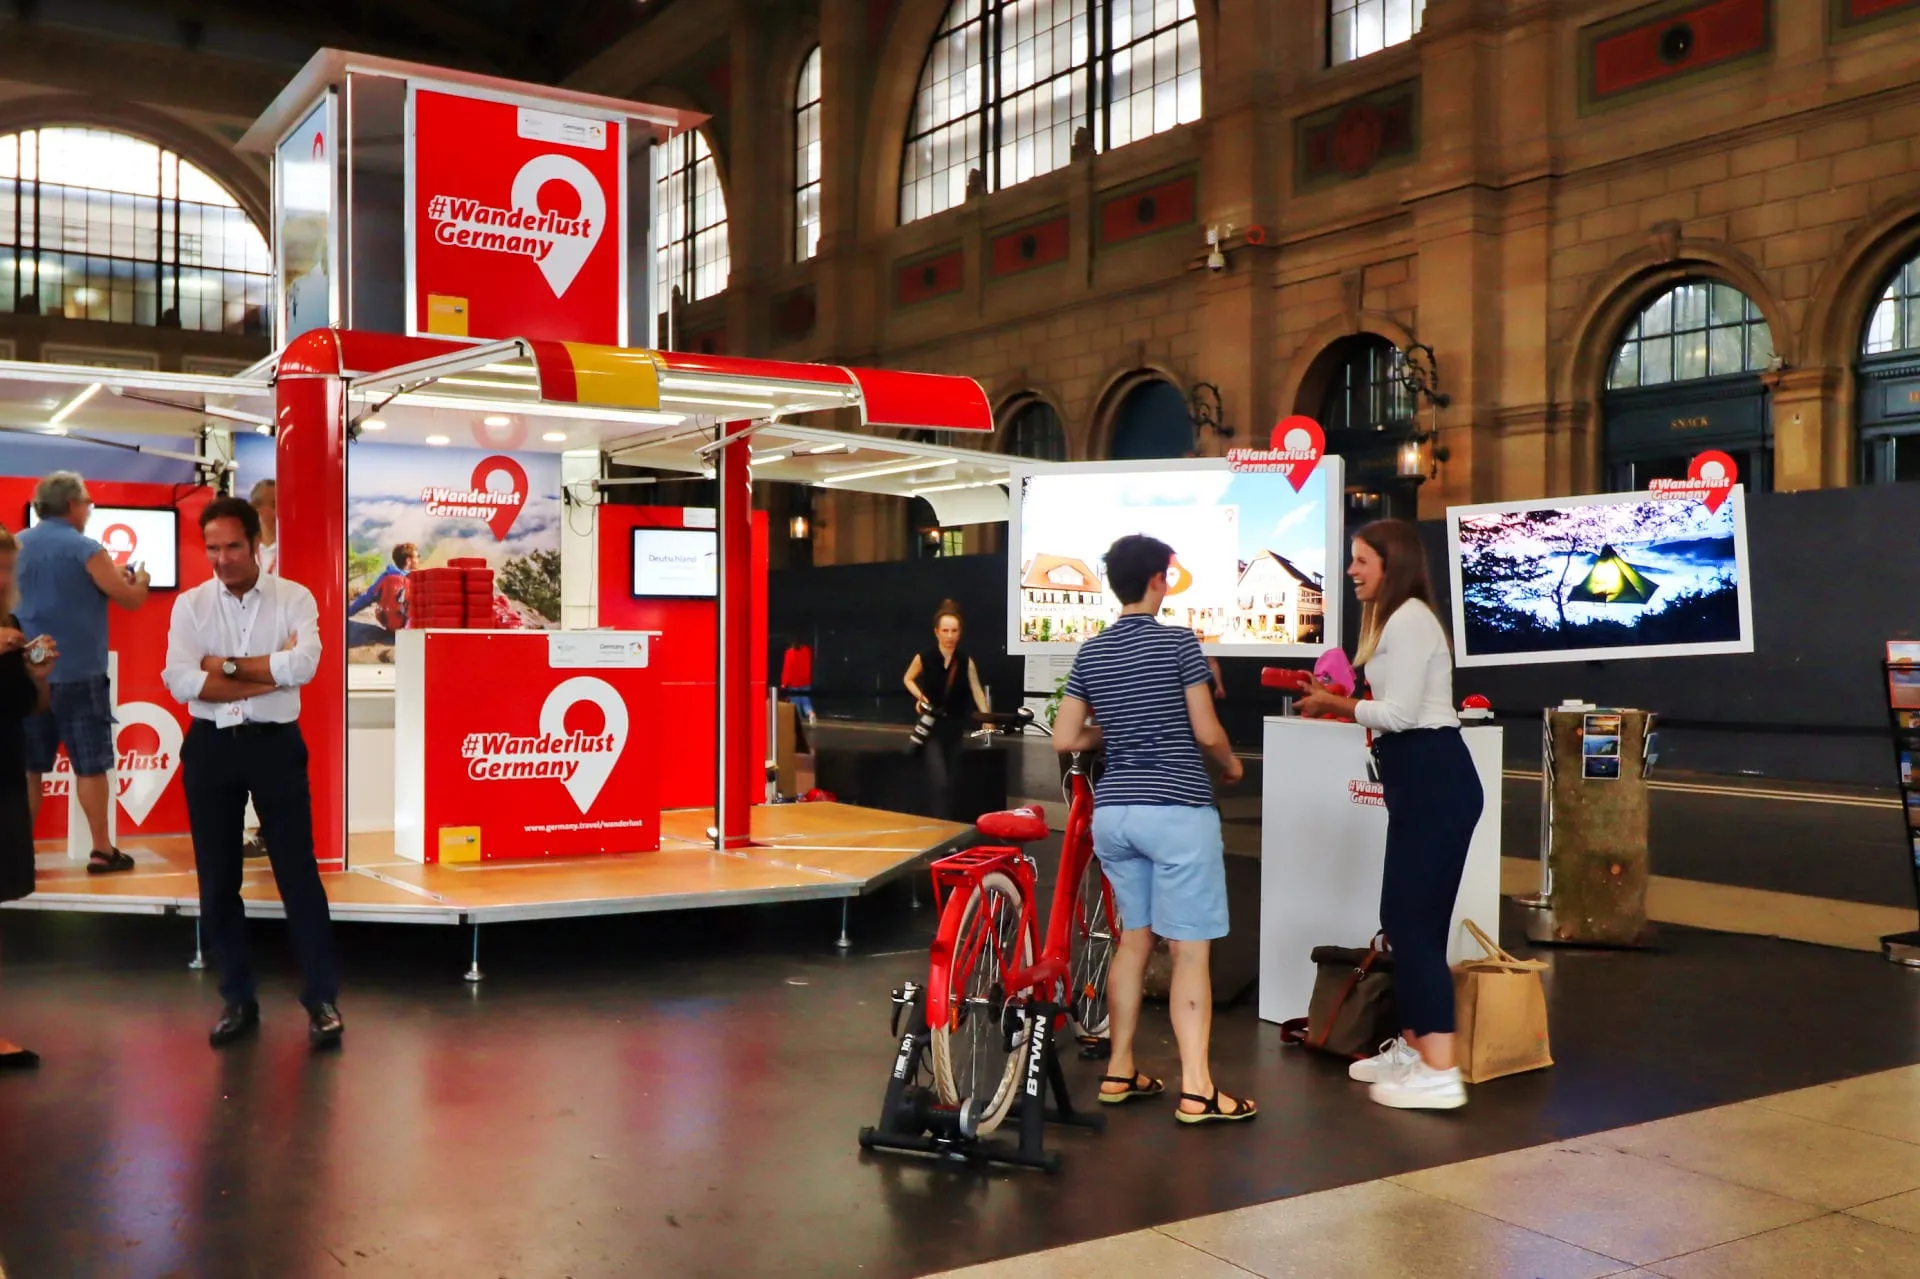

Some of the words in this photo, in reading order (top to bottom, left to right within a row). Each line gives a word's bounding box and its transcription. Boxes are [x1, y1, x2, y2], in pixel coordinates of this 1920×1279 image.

[429, 196, 591, 238] #Wanderlust
[436, 222, 554, 262] Germany
[1227, 447, 1317, 461] #Wanderlust
[1230, 461, 1295, 477] Germany
[1648, 477, 1730, 490] #Wanderlust
[421, 487, 520, 505] #Wanderlust
[1652, 490, 1710, 501] Germany
[426, 502, 498, 522] Germany
[648, 554, 697, 563] Deutschland
[463, 731, 615, 756] #Wanderlust
[470, 757, 580, 782] Germany
